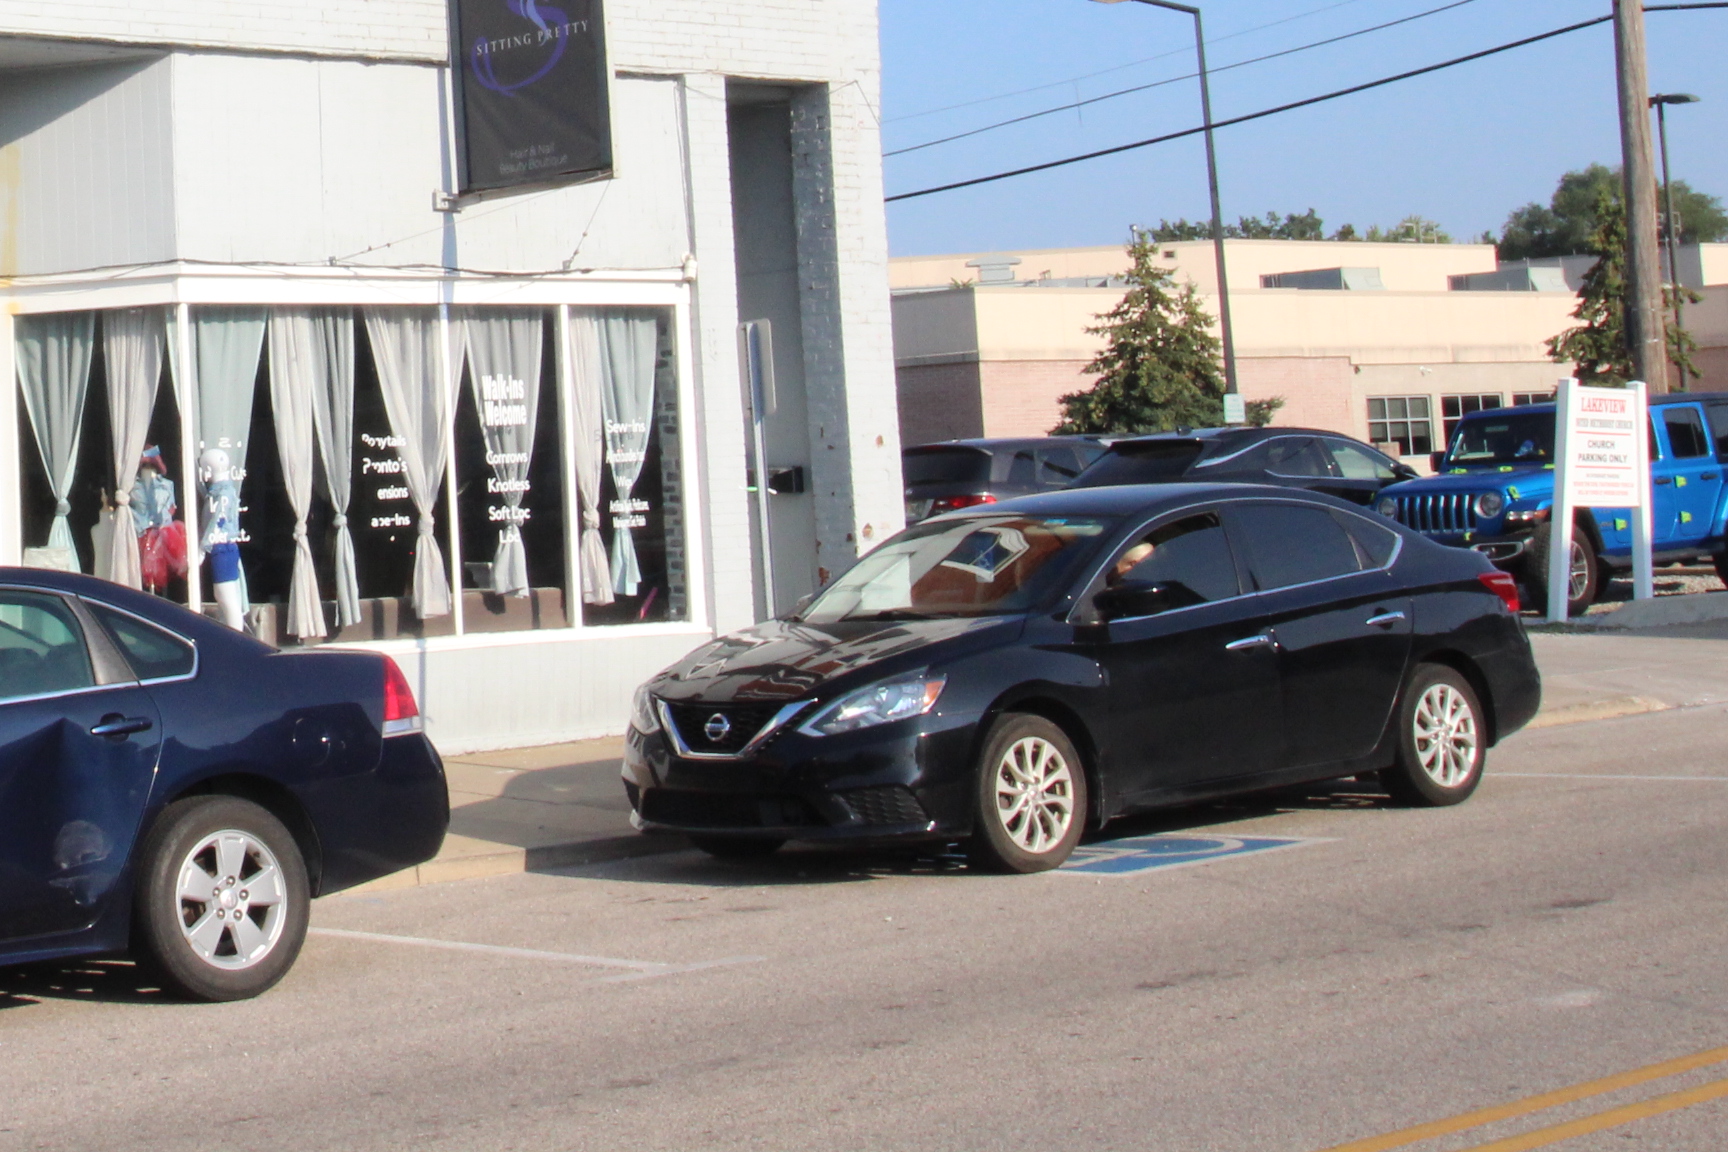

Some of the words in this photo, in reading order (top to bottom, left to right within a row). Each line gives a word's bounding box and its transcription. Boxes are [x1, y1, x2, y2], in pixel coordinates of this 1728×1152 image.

[476, 33, 532, 56] SITTING
[537, 19, 588, 43] PRETTY
[482, 373, 524, 400] Walk-Ins
[484, 400, 527, 426] Welcome
[1581, 397, 1626, 414] LAKEVIEW
[606, 416, 646, 433] Sew-Ins
[1587, 440, 1615, 450] CHURCH
[485, 450, 528, 465] Cornrows
[1578, 453, 1607, 463] PARKING
[1608, 454, 1627, 464] ONLY
[487, 478, 530, 493] Knotless
[488, 506, 510, 521] Soft
[511, 507, 531, 520] Loc
